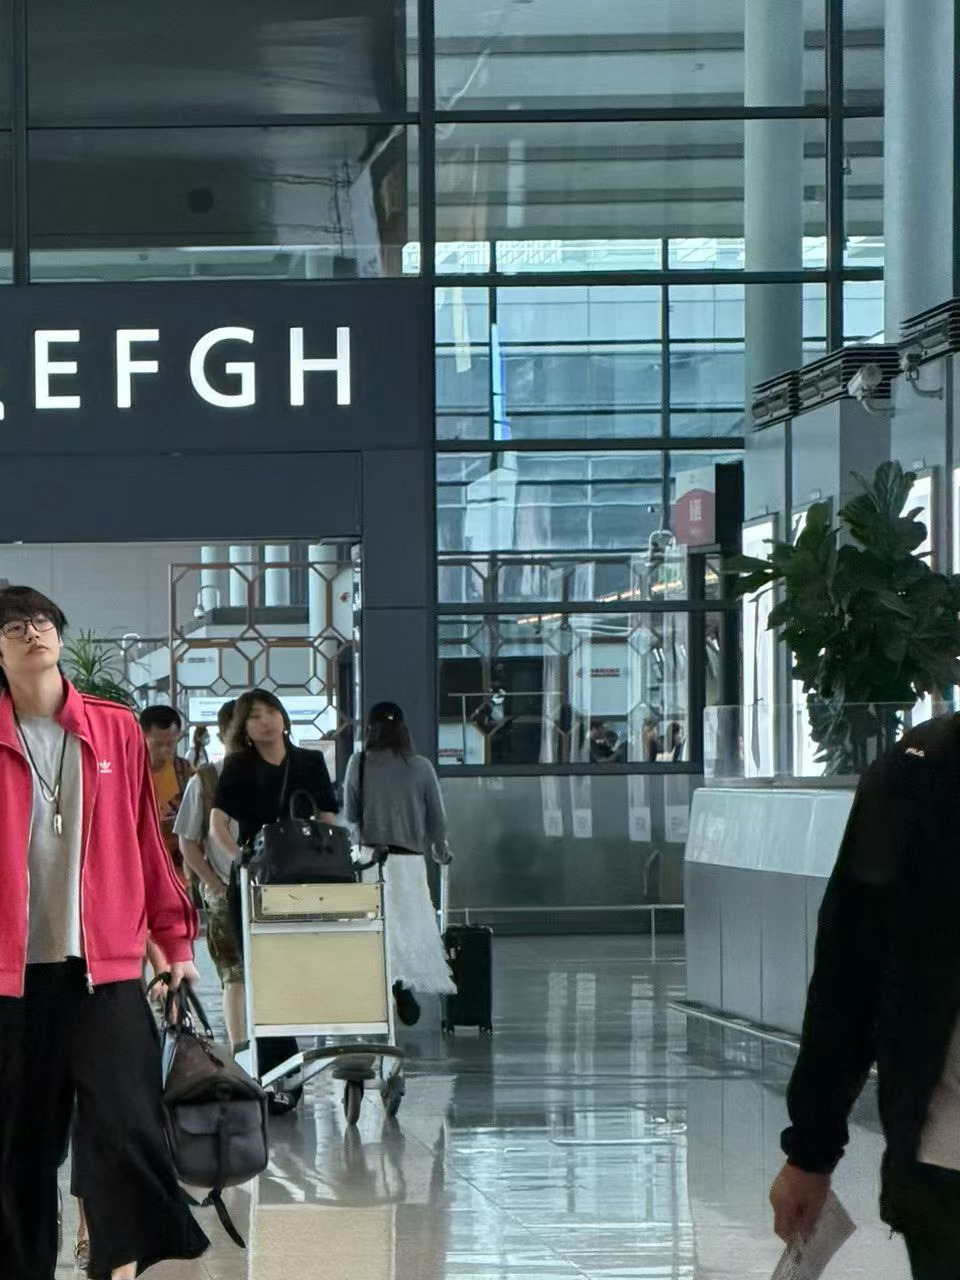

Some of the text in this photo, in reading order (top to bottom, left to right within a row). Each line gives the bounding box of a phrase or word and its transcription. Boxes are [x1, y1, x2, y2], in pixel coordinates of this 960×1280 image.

[34, 326, 351, 409] E F G H
